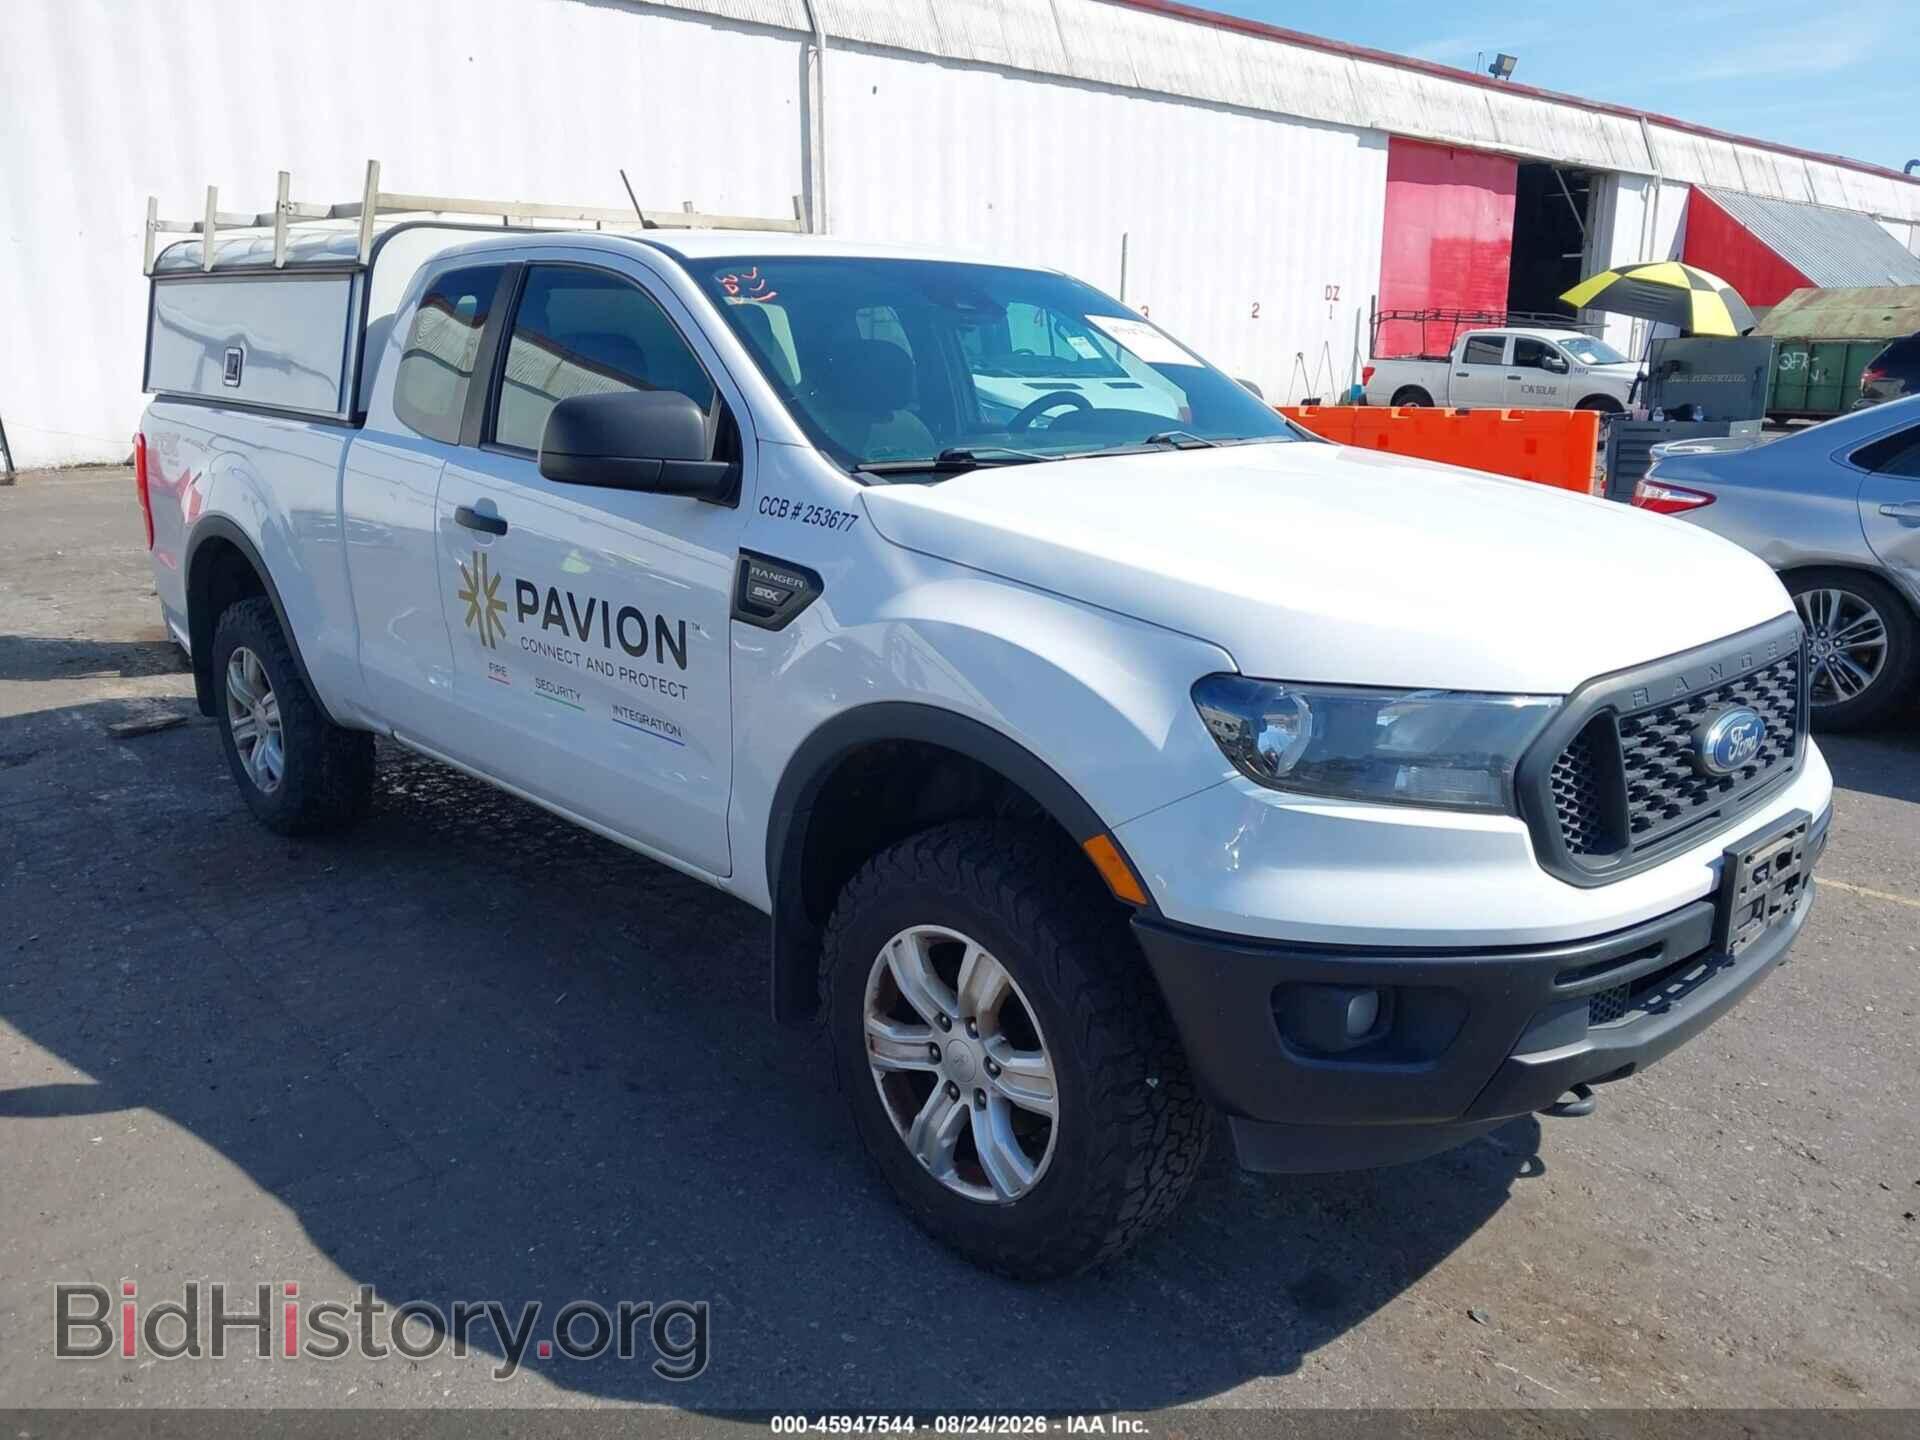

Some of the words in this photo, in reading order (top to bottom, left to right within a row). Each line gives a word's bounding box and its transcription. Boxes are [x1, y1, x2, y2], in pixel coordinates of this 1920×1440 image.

[1252, 303, 1260, 318] 2
[759, 496, 790, 518] CCB
[790, 502, 803, 520] #
[802, 505, 859, 531] 253677
[752, 567, 804, 589] RANGER
[515, 578, 688, 671] PAVION
[488, 662, 507, 677] FIRE
[520, 636, 581, 666] CONNECT
[586, 656, 615, 678] AND
[619, 666, 688, 700] PROTECT
[535, 677, 582, 702] SECURITY
[612, 705, 683, 738] INTEGRATION
[1728, 722, 1759, 760] Ford
